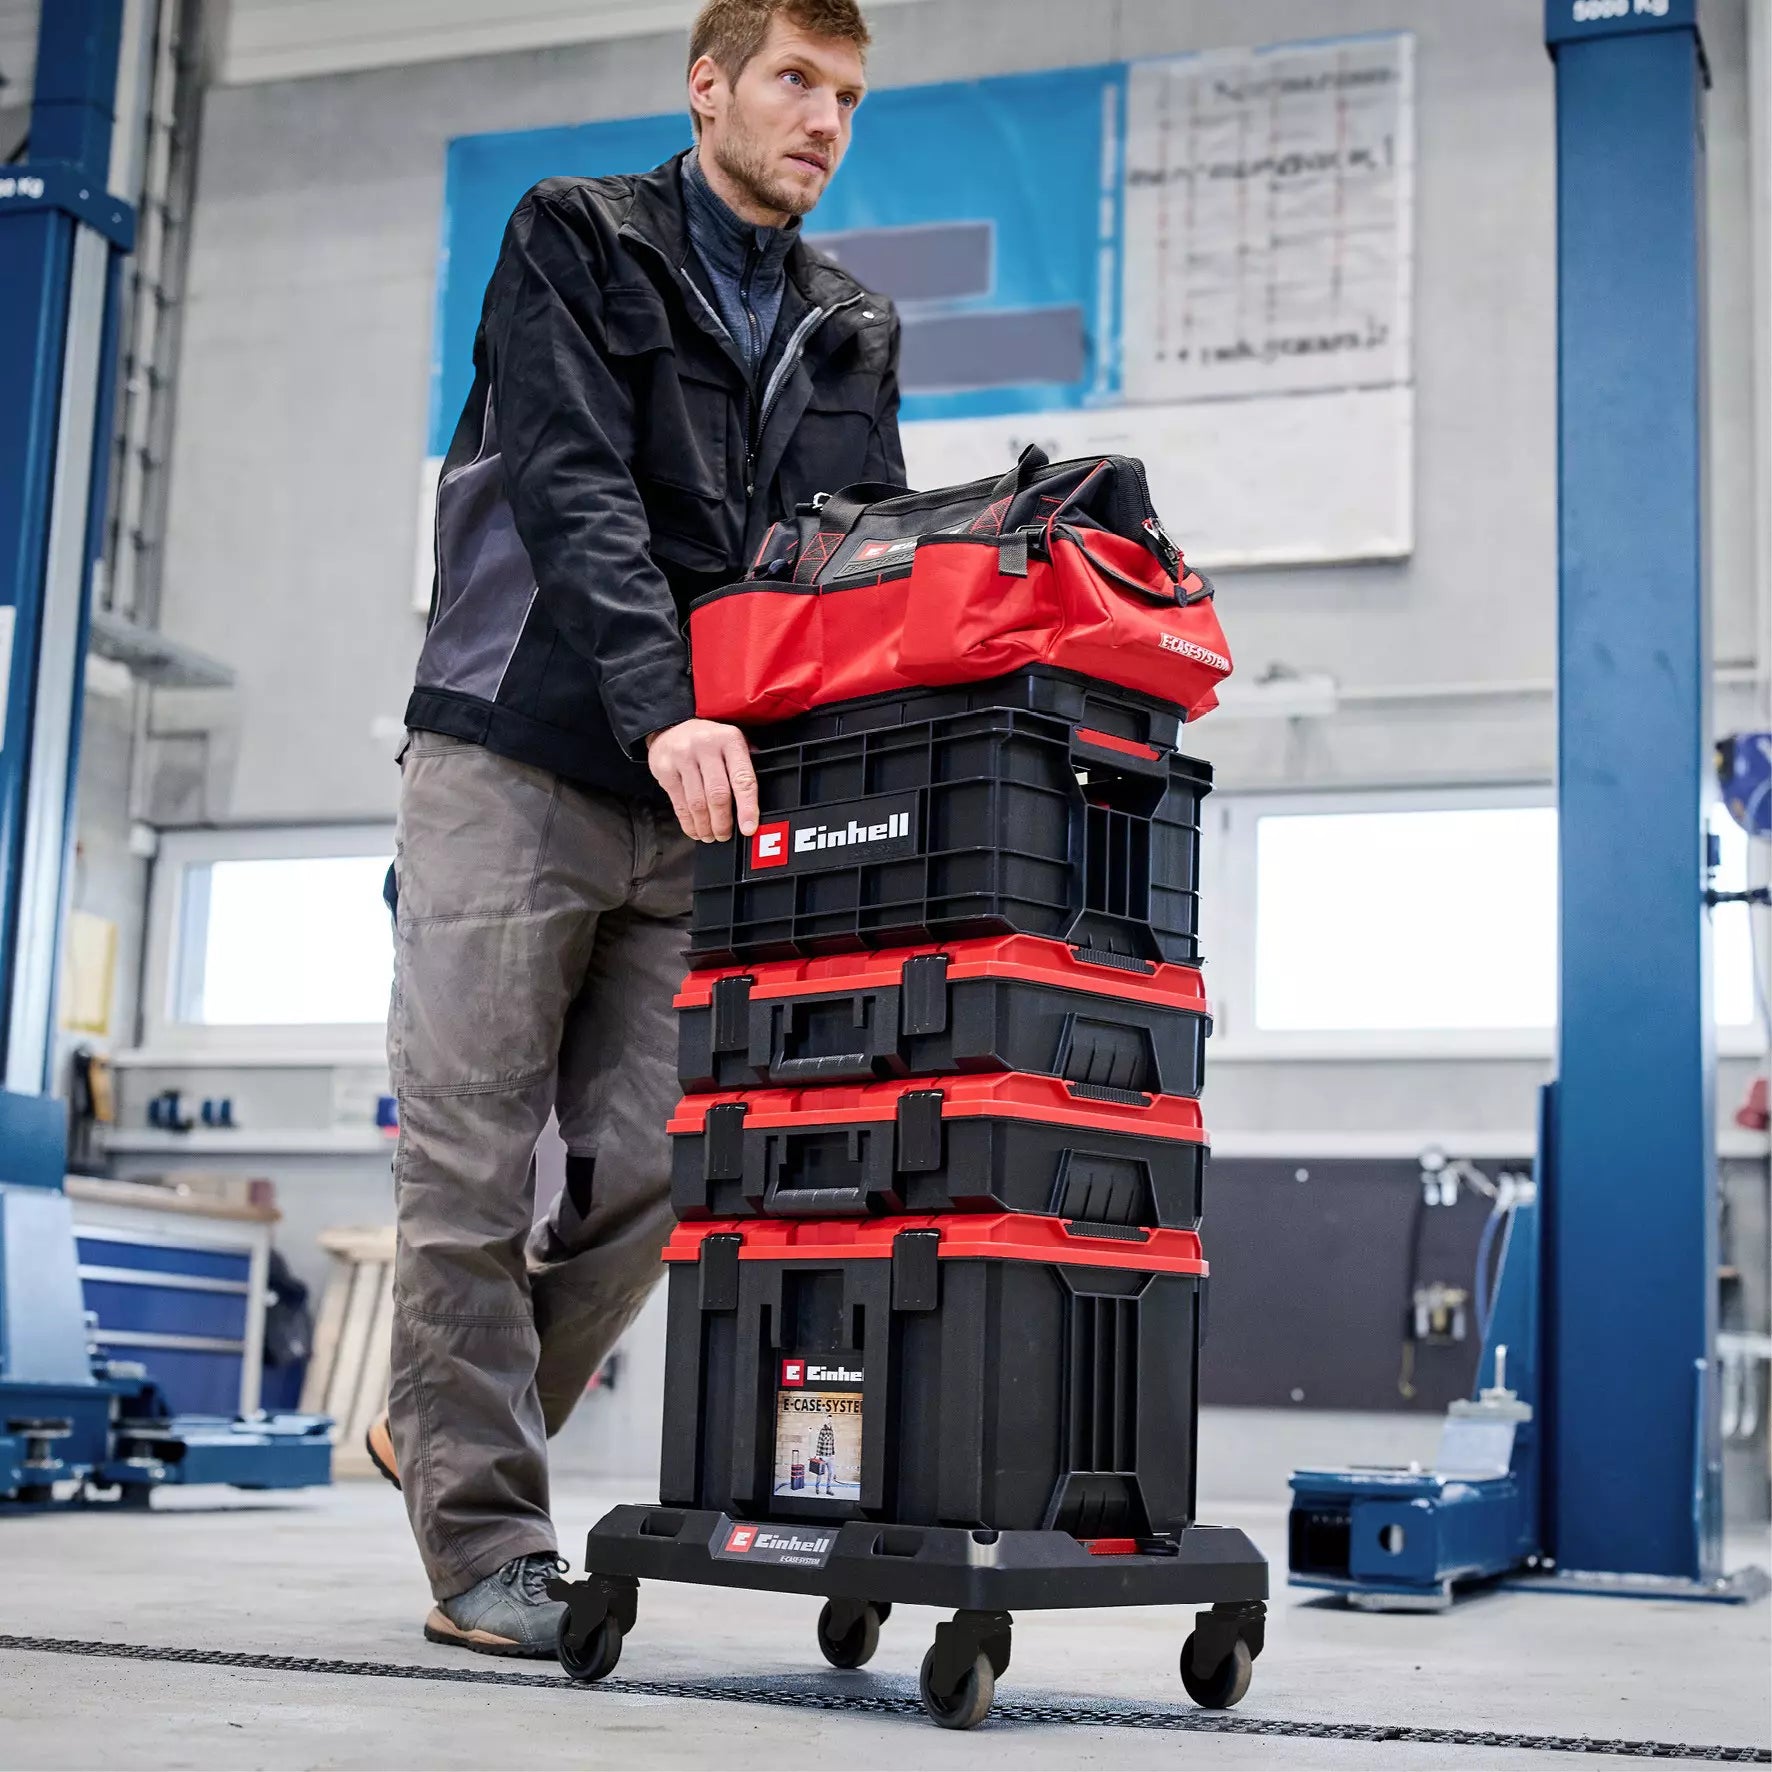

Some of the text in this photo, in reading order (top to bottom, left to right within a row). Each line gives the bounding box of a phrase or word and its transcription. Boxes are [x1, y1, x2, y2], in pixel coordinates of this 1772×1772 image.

[794, 812, 909, 853] Einhell
[783, 1398, 864, 1413] E-CASE-SYSTE
[754, 1533, 830, 1553] Einhell
